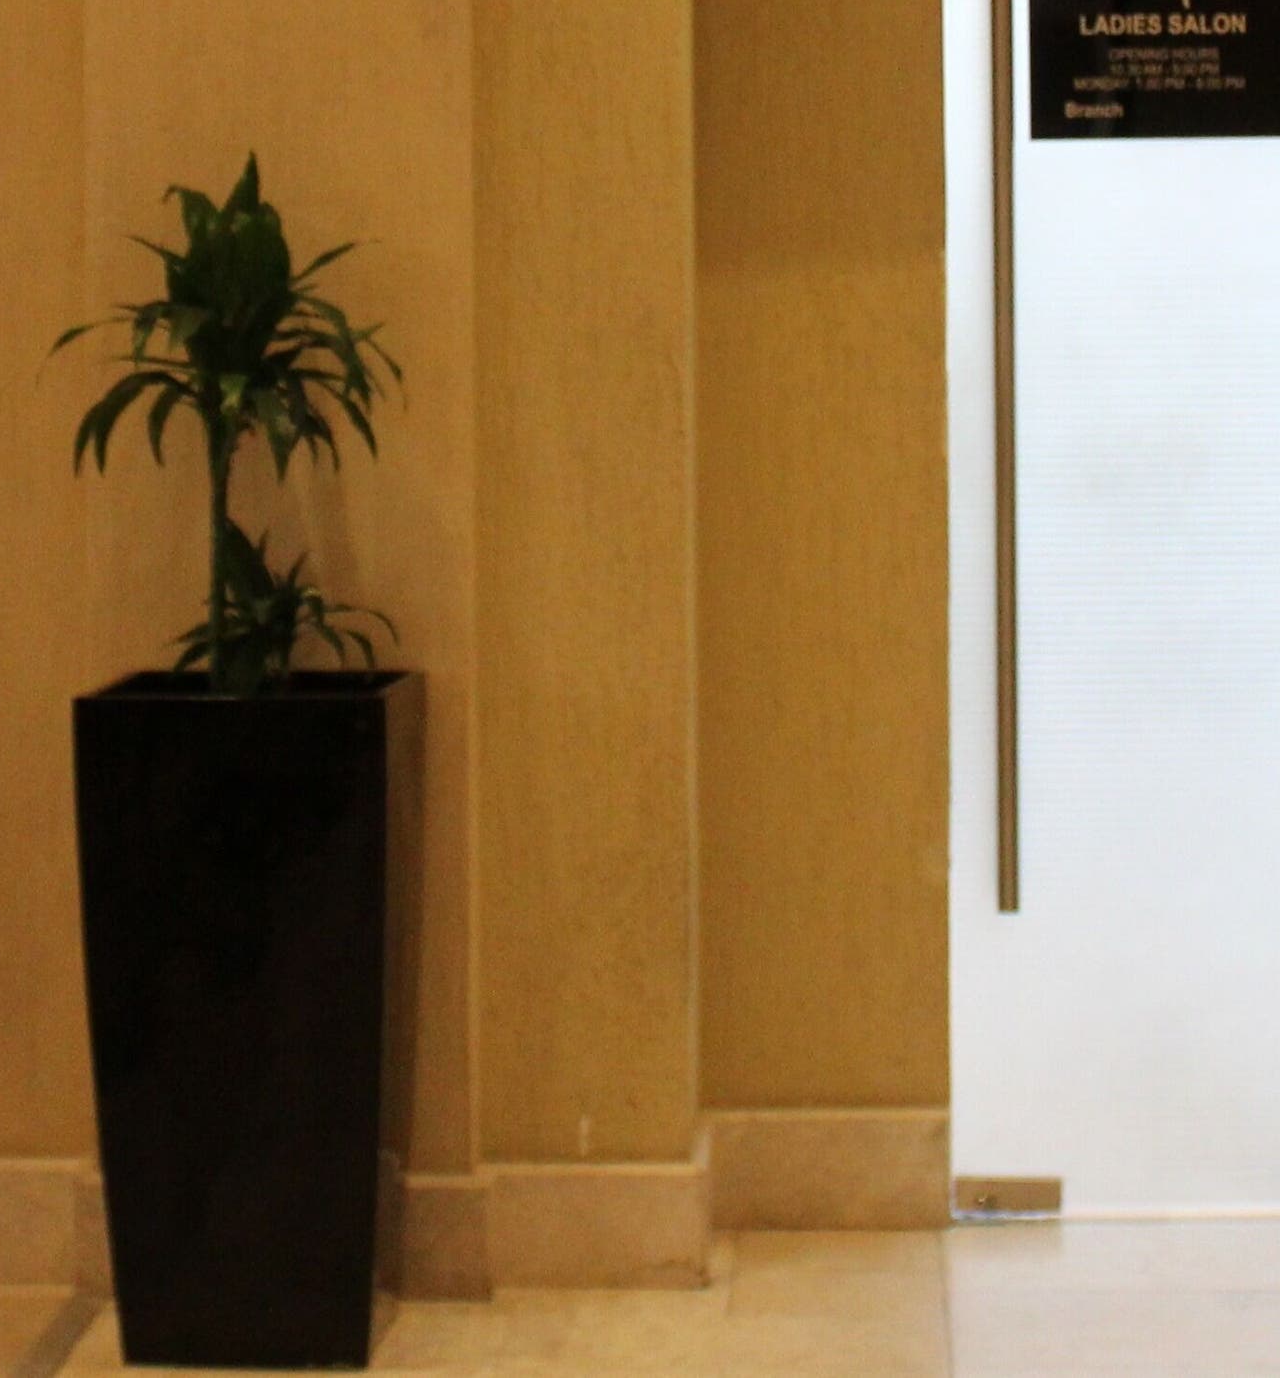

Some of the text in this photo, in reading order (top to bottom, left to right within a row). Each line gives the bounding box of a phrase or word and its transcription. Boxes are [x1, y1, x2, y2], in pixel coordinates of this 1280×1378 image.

[1079, 12, 1248, 36] LADIES SALON
[1063, 101, 1124, 119] Branch
